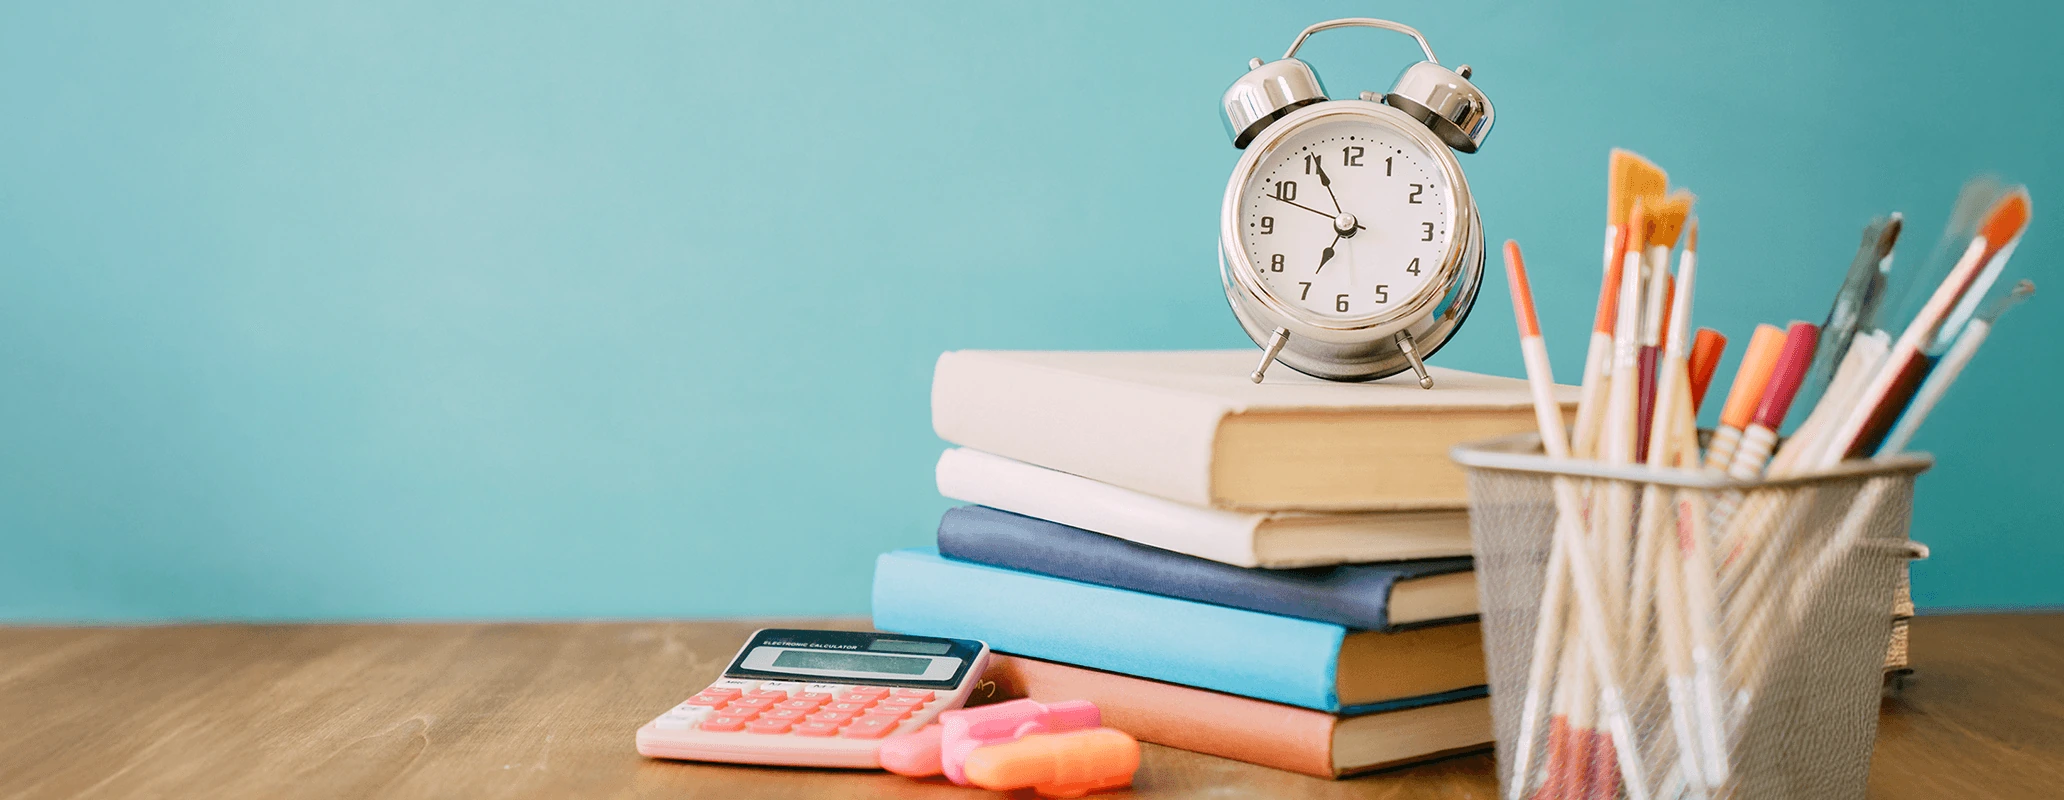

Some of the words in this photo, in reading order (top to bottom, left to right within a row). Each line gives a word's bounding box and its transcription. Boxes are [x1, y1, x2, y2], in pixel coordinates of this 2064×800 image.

[1304, 154, 1322, 175] 11
[1342, 146, 1365, 167] 12
[1385, 156, 1393, 177] 1
[1274, 181, 1297, 201] 10
[1409, 183, 1423, 204] 2
[1260, 216, 1274, 235] 9
[1421, 222, 1434, 242] 3
[1271, 253, 1285, 273] 8
[1406, 257, 1421, 277] 4
[1298, 281, 1312, 301] 7
[1375, 284, 1389, 304] 5
[1335, 294, 1349, 313] 6
[762, 640, 808, 648] ELECTRONIC
[809, 642, 858, 650] CALCULATOR
